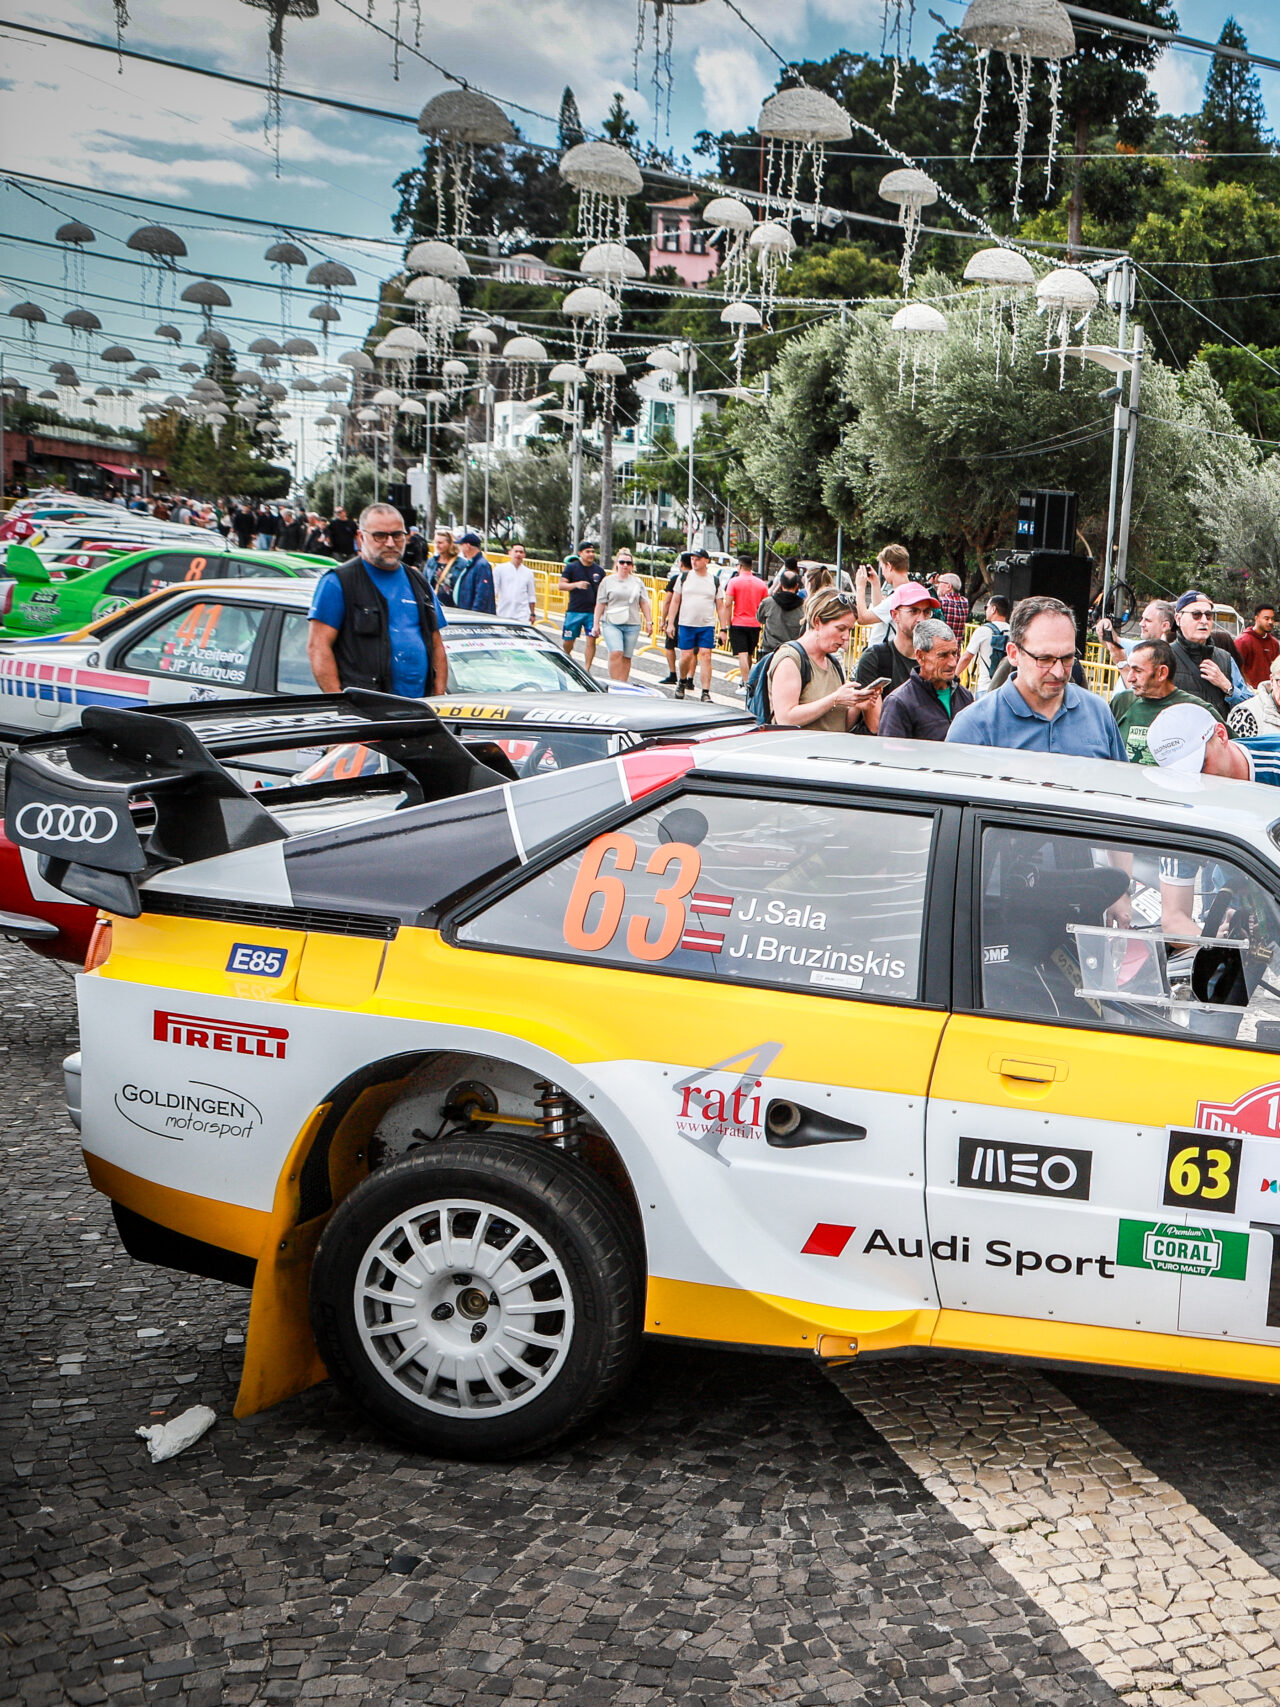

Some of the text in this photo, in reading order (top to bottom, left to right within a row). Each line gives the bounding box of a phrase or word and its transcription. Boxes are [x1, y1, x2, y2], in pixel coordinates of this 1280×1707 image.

[176, 604, 222, 648] 41
[173, 643, 244, 664] J. Azeiteiro
[169, 660, 246, 682] JP Marques
[563, 833, 701, 961] 63
[738, 898, 827, 931] J.Sala
[232, 948, 282, 974] E85
[729, 935, 906, 979] J.Bruzinskis
[153, 1010, 290, 1060] PIRELLI
[122, 1083, 245, 1118] GOLDINGEN
[676, 1080, 762, 1128] rati
[165, 1112, 253, 1139] motorsport
[675, 1120, 763, 1140] www.4rati.lv
[970, 1146, 1078, 1191] MEO
[1169, 1146, 1232, 1200] 63
[1165, 1226, 1203, 1238] Premium
[862, 1229, 1116, 1279] Audi Sport
[1153, 1239, 1212, 1263] CORAL
[1156, 1261, 1207, 1275] PURO MALTE
